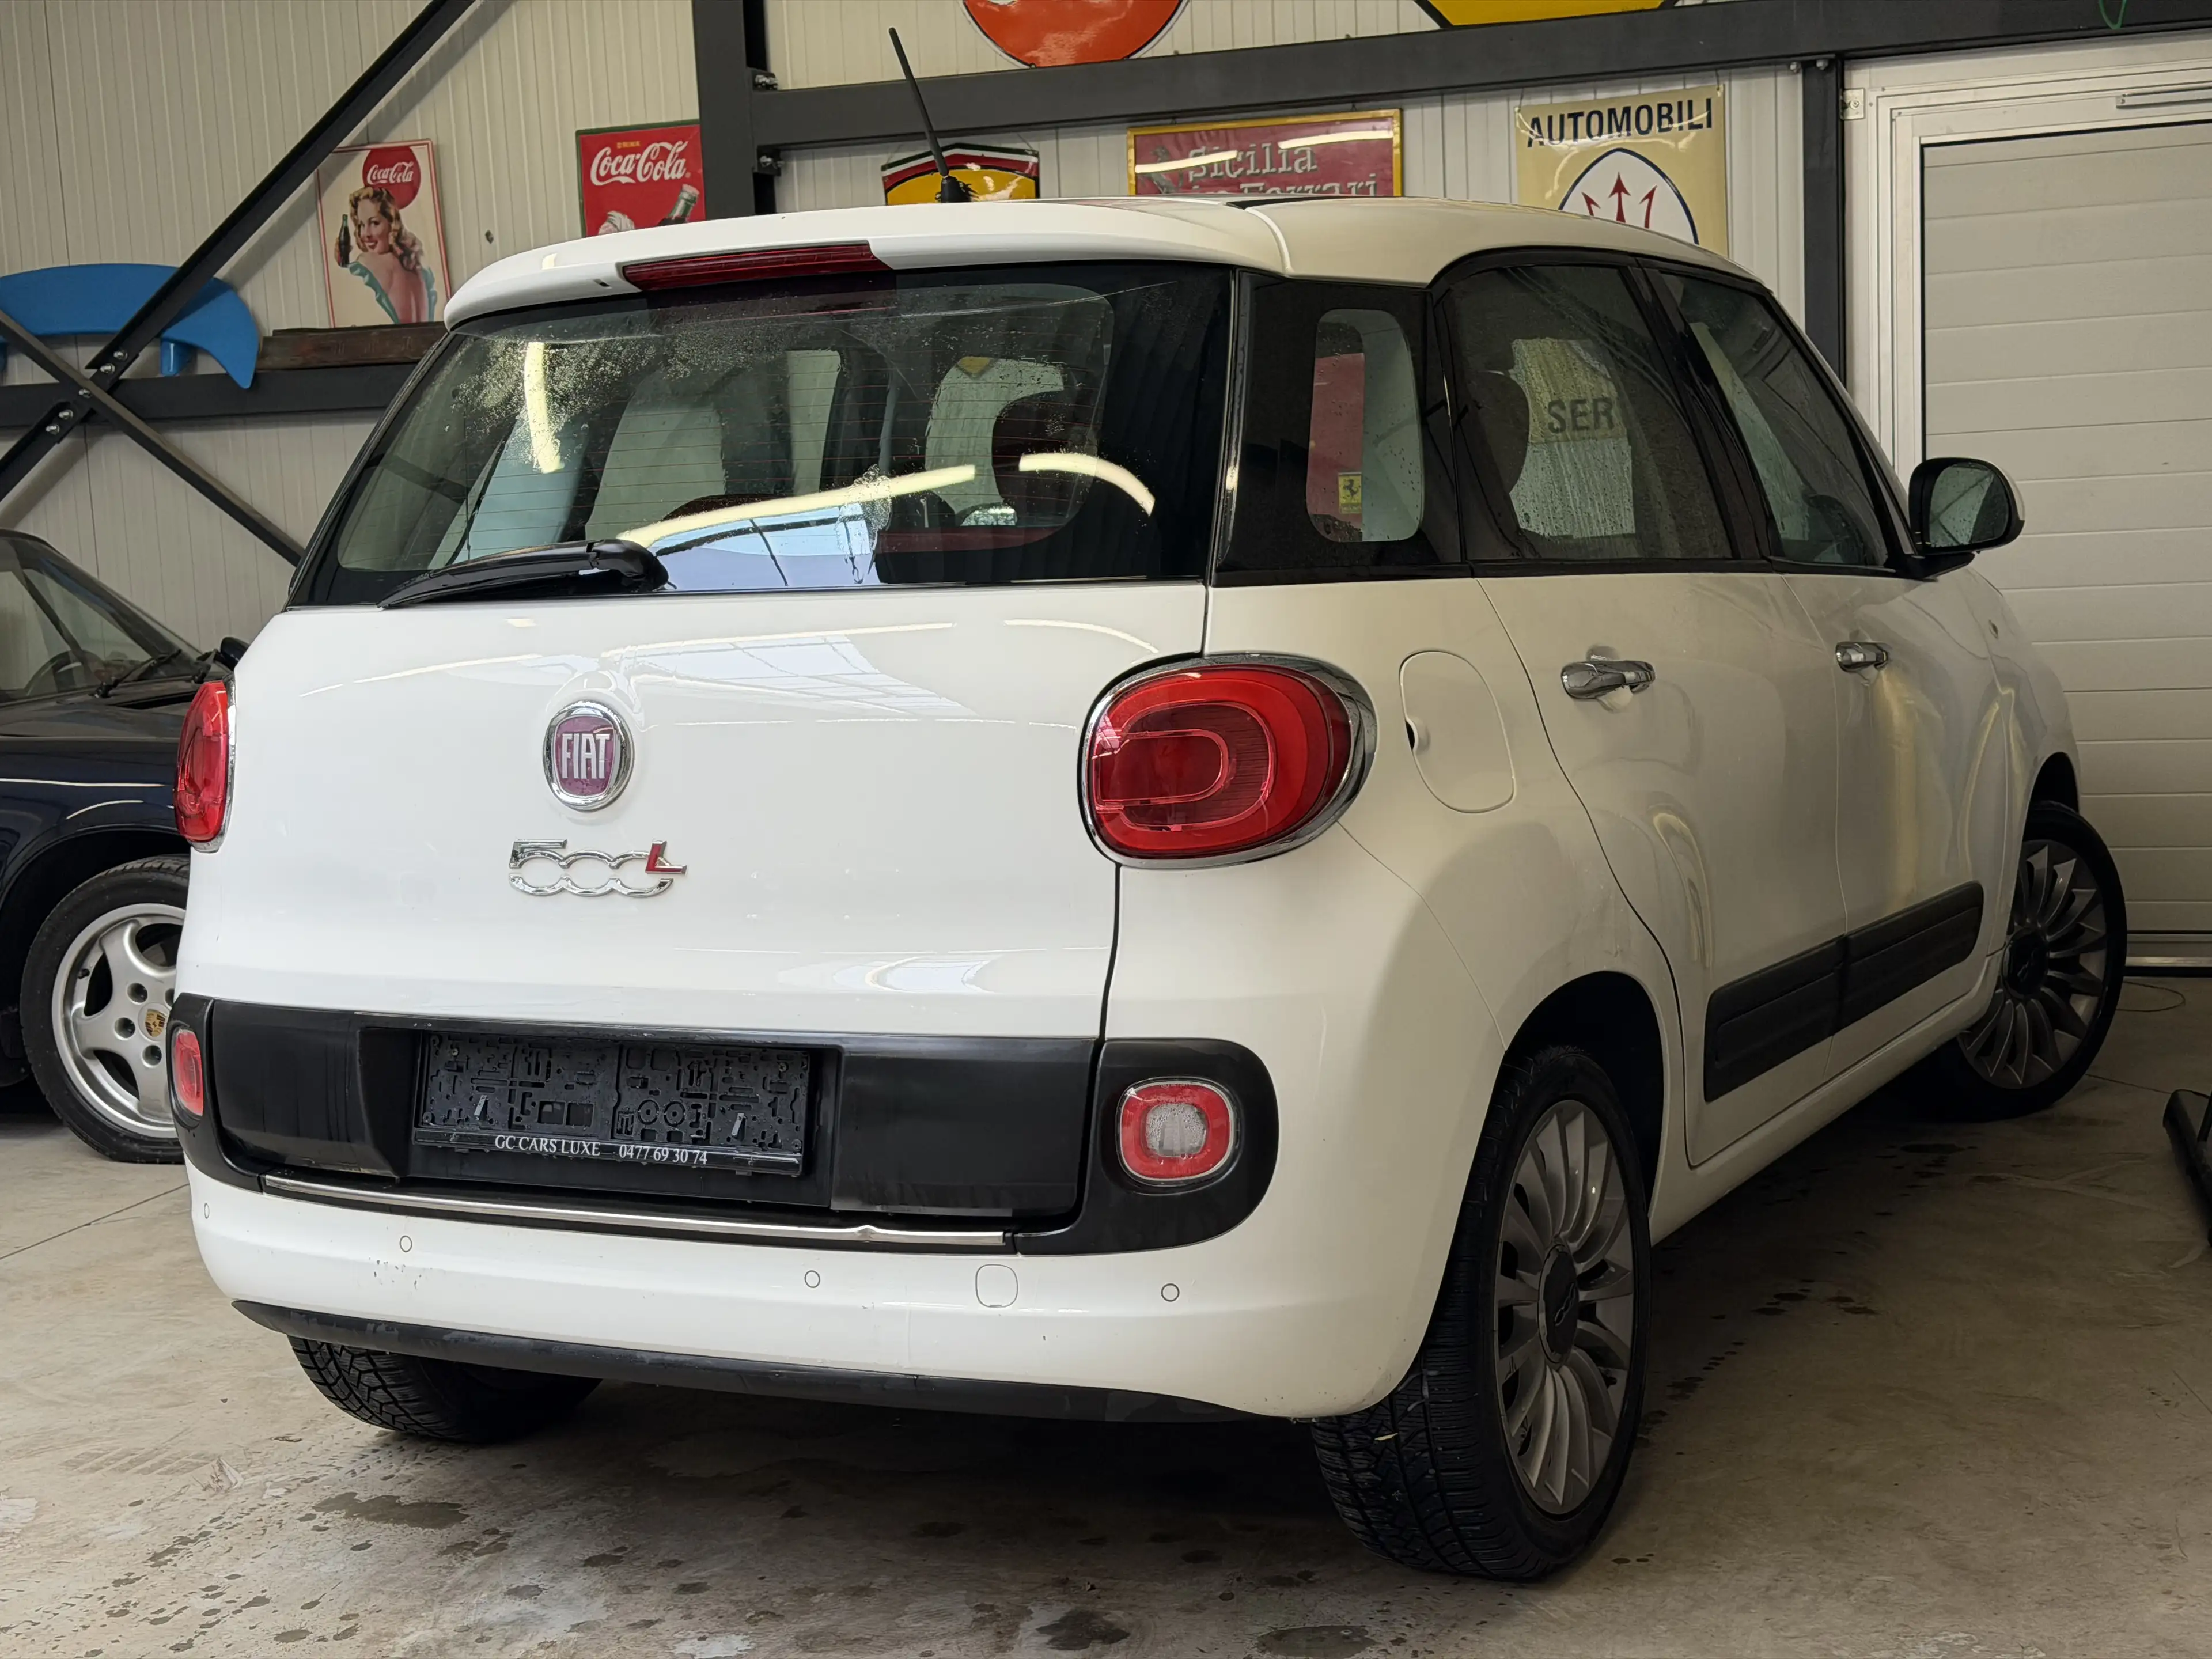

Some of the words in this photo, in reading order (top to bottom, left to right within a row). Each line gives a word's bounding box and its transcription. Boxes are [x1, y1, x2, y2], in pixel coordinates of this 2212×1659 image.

[1527, 98, 1713, 147] AUTOMOBILI
[1188, 143, 1316, 182] Sicilia
[1547, 397, 1615, 434] SER
[562, 733, 611, 779] FIAT
[509, 838, 688, 898] 500L
[495, 1134, 516, 1150] GC
[518, 1136, 557, 1153] CARS
[561, 1139, 601, 1156] LUXE
[619, 1144, 650, 1160] 0477
[653, 1147, 669, 1161] 69
[672, 1148, 688, 1164] 30
[692, 1150, 708, 1165] 74
